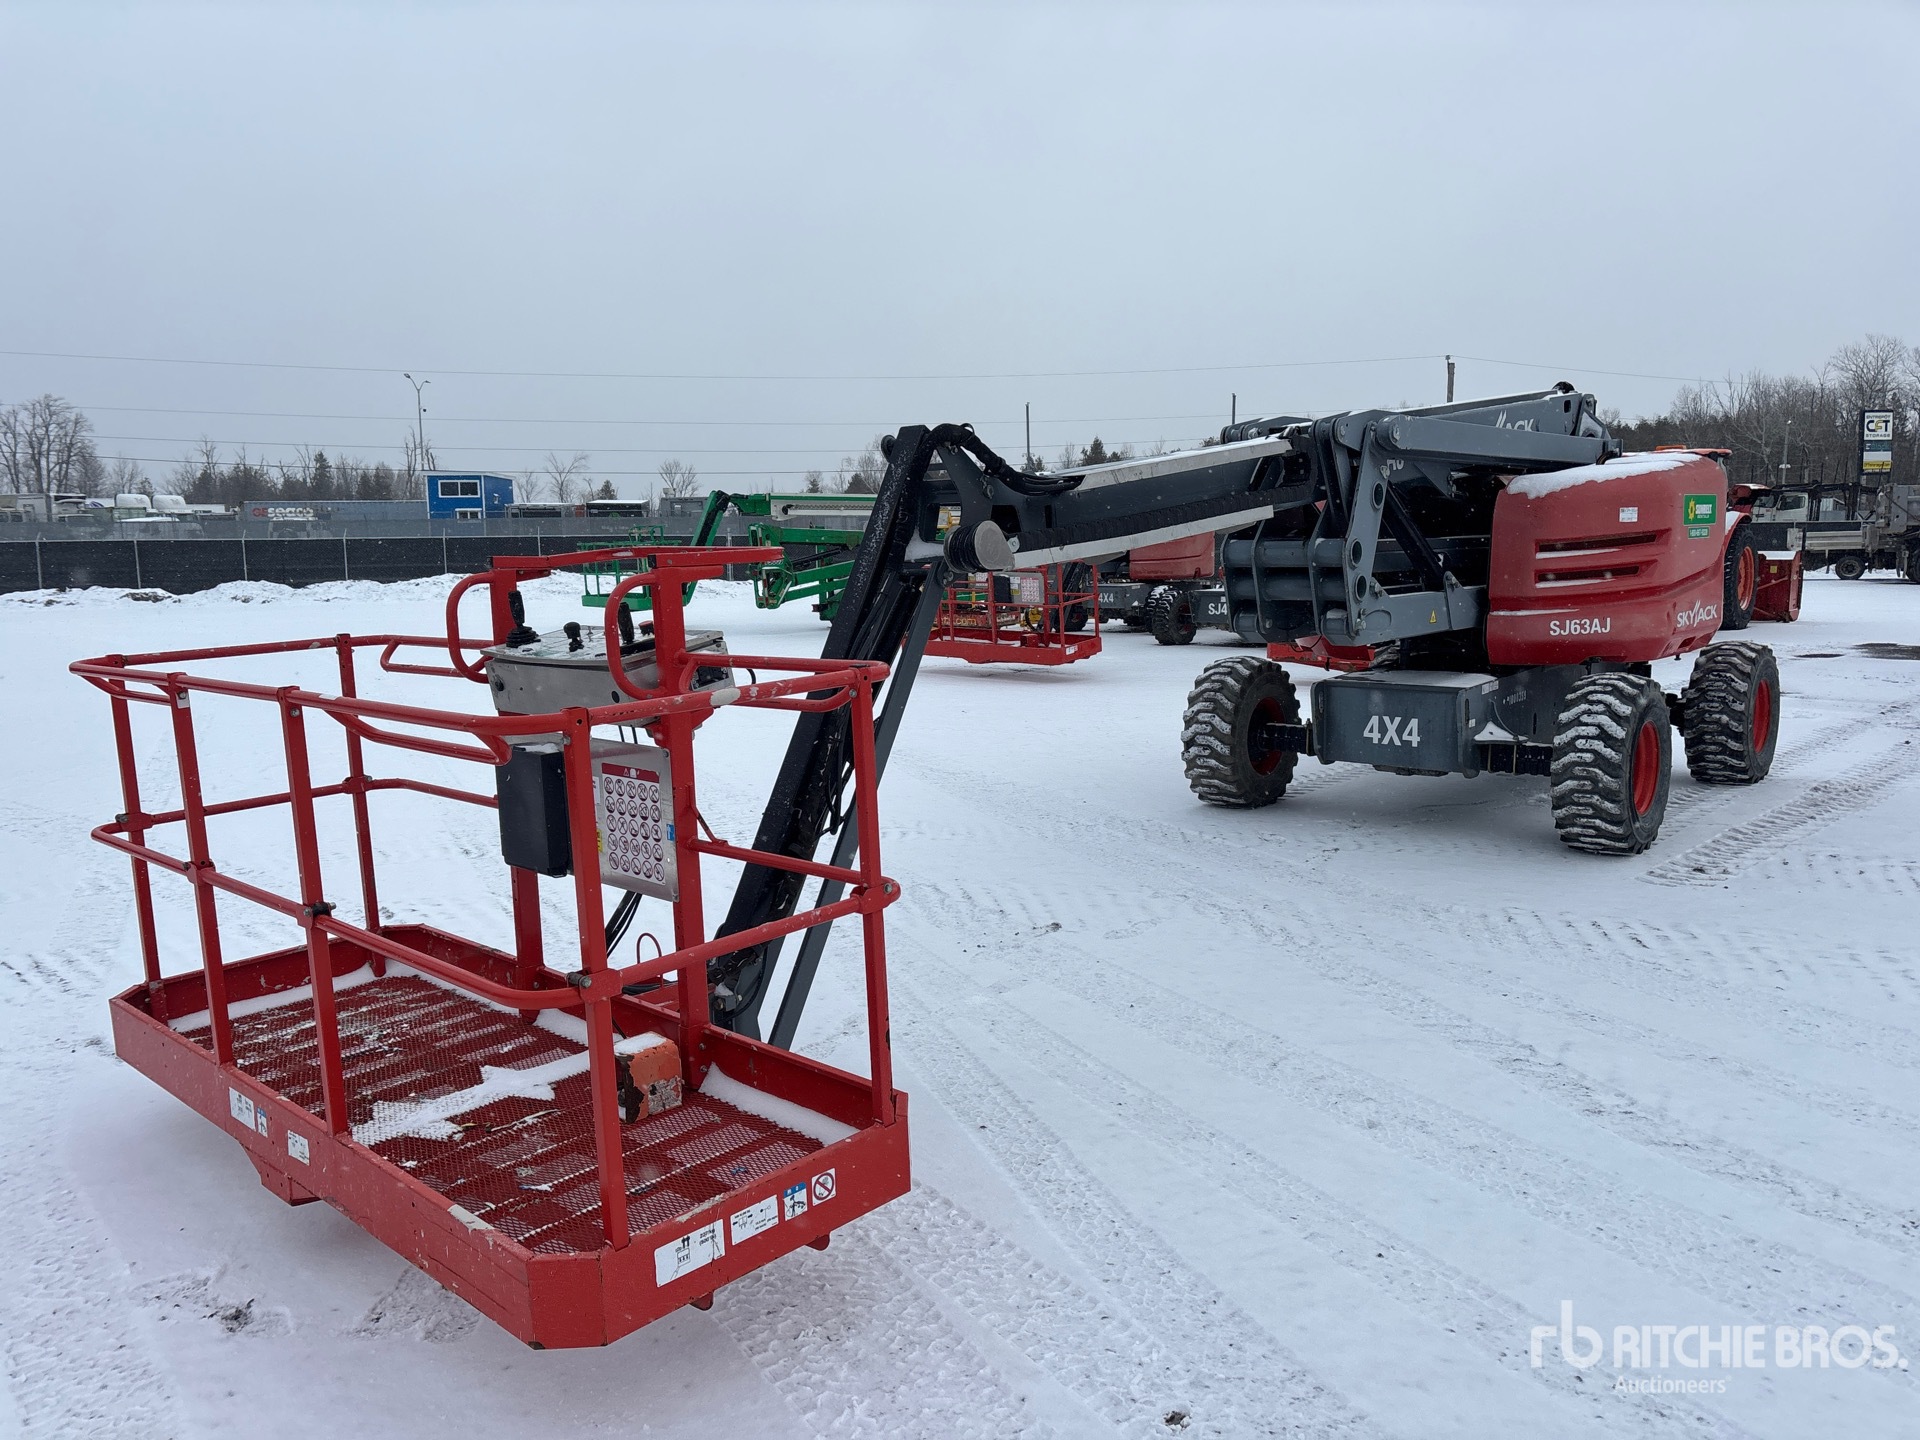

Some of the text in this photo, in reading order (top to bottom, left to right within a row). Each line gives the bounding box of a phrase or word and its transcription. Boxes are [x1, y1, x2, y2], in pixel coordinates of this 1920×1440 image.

[1866, 419, 1890, 432] CFT
[1098, 592, 1114, 603] 4X4
[1677, 600, 1718, 628] SKYJACK
[1549, 617, 1611, 636] SJ63AJ
[1363, 715, 1421, 747] 4X4
